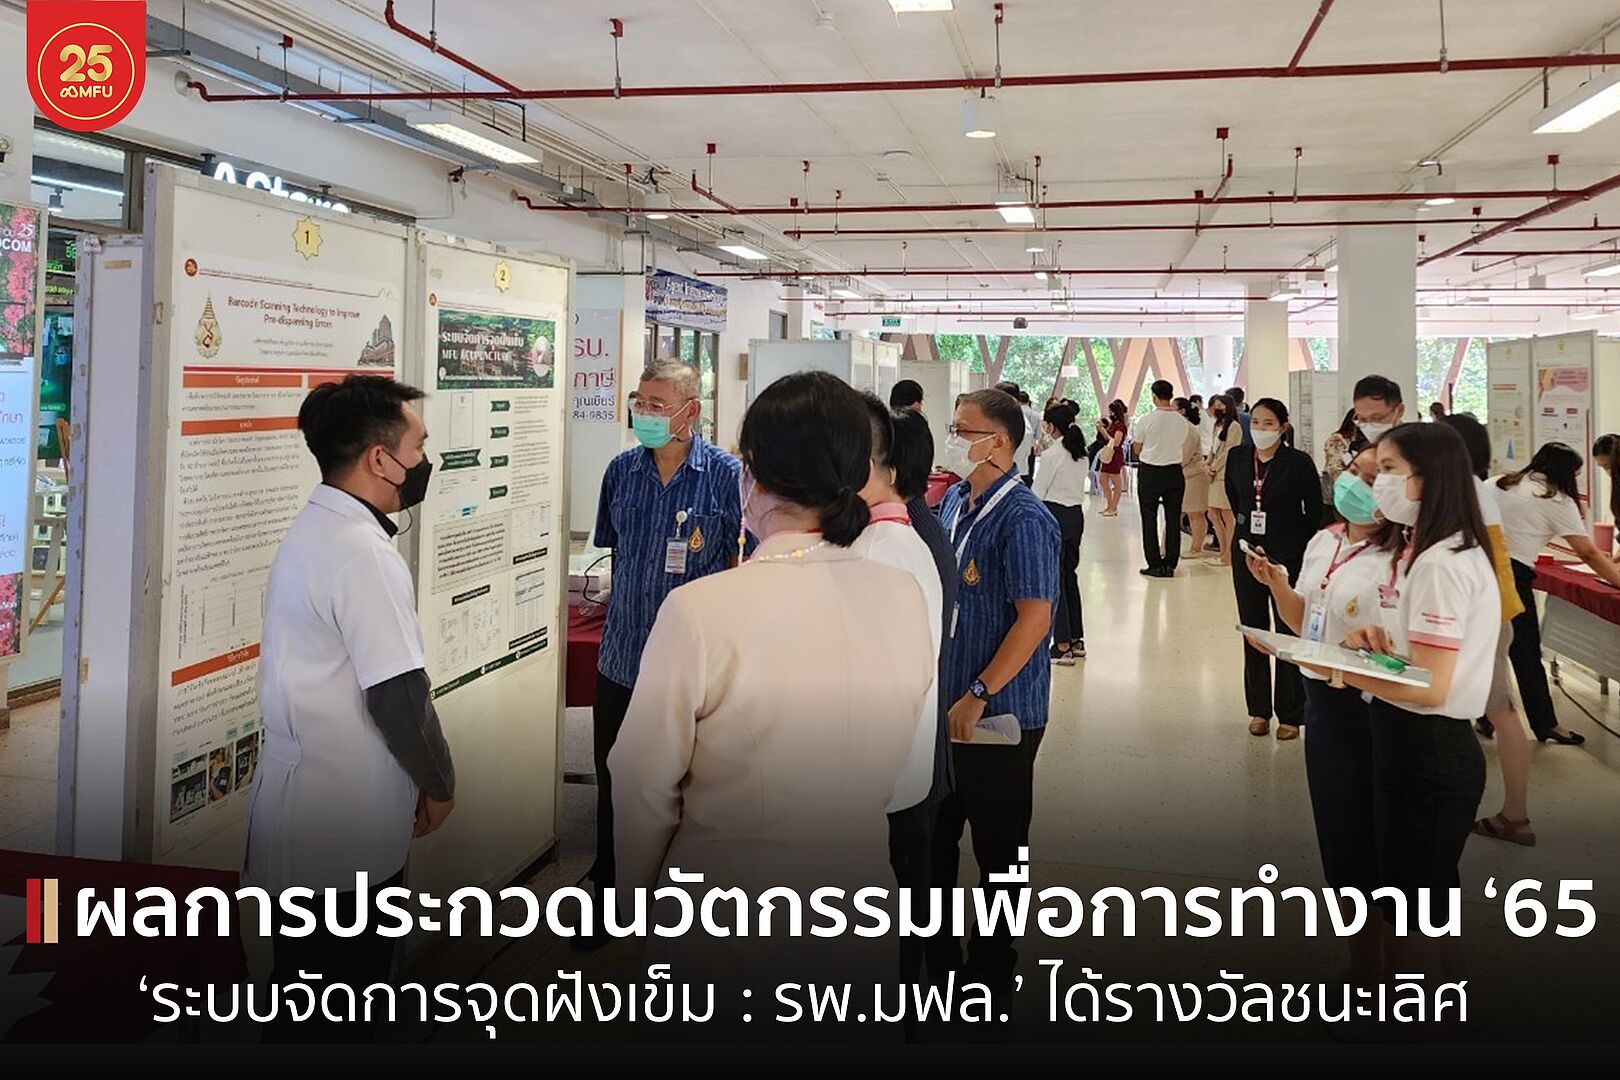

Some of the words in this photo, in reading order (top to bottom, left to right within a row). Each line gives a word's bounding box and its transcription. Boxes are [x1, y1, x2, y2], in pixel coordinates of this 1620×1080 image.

[0, 237, 32, 252] COM
[304, 230, 310, 245] 1
[499, 269, 506, 281] 2
[228, 296, 258, 309] Barcode
